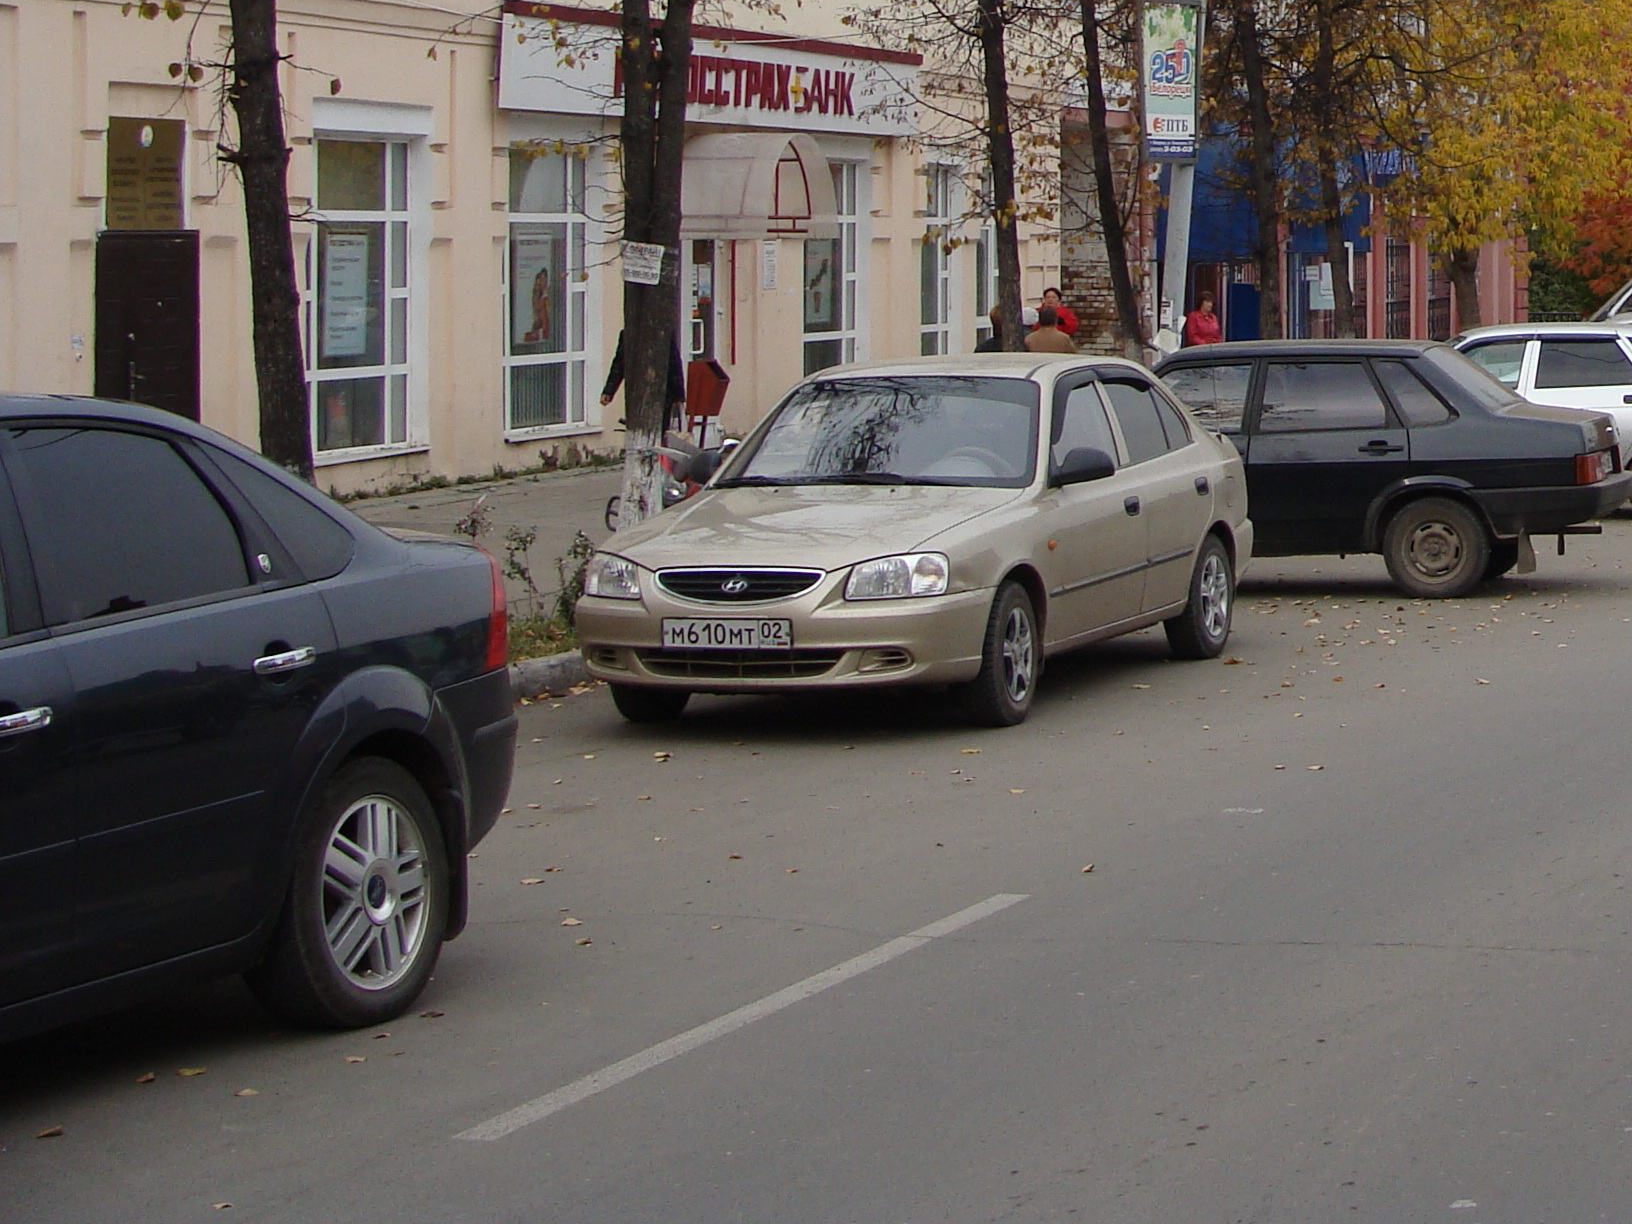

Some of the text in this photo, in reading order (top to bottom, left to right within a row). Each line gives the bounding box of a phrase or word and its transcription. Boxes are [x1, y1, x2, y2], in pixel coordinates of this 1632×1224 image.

[1151, 49, 1191, 84] 250
[614, 46, 855, 116] ОССТРАХ БАНК
[1166, 119, 1188, 132] ПТБ
[672, 622, 782, 644] М610МТ 02
